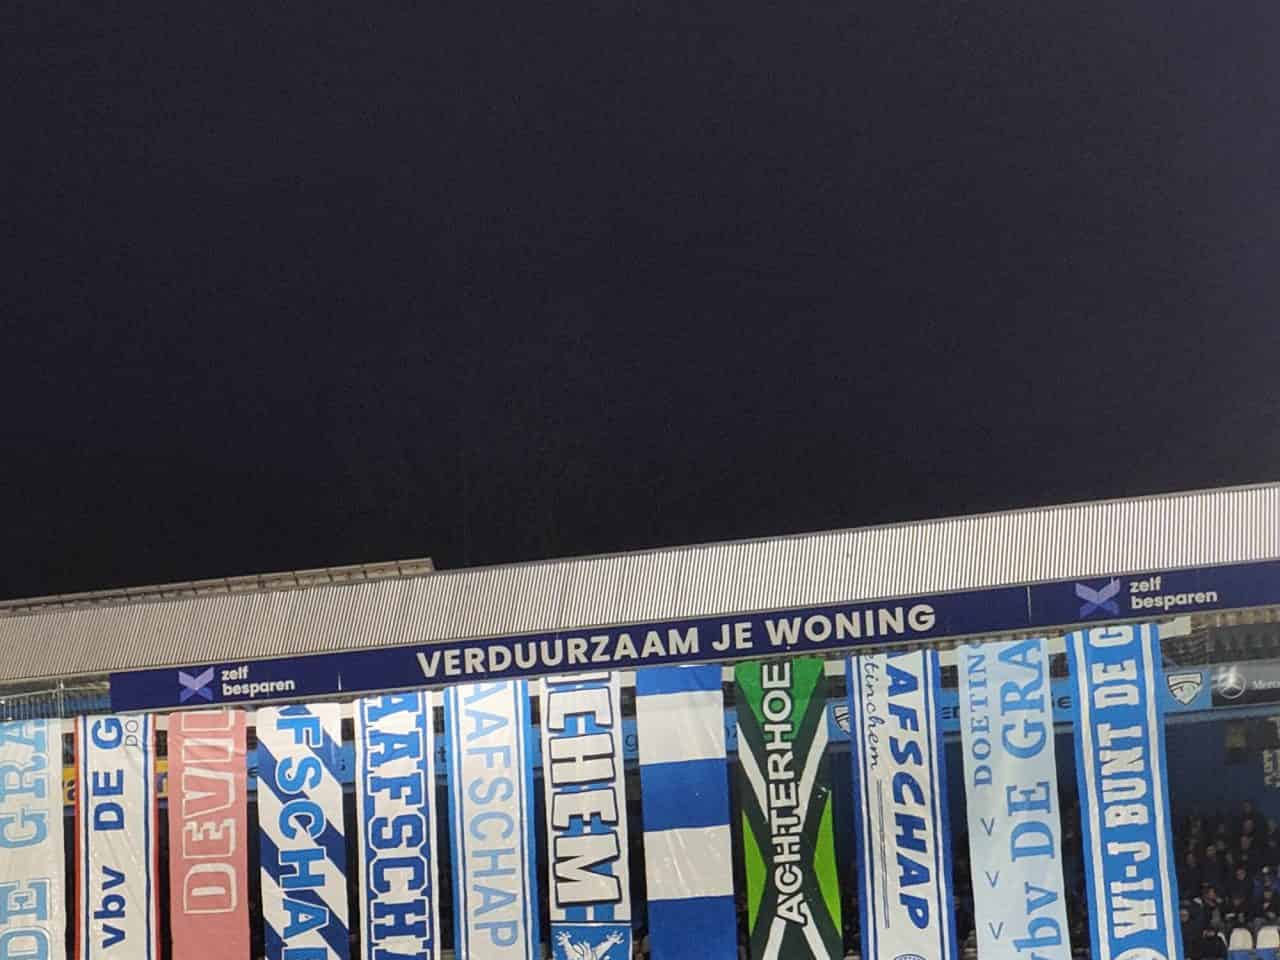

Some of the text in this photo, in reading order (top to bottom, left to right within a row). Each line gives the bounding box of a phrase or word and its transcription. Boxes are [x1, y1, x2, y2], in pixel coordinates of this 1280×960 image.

[1130, 576, 1162, 593] zelf
[1131, 590, 1218, 611] besparen
[222, 665, 249, 681] zelf
[417, 604, 936, 678] VERDUURZAAM JE WONING
[222, 679, 296, 698] besparen
[997, 638, 1048, 760] GRA
[1091, 658, 1140, 710] DE
[762, 661, 808, 926] ACHTERHOE
[1096, 721, 1150, 829] BUNT
[91, 717, 127, 950] vbv DE G
[1005, 780, 1056, 863] DE
